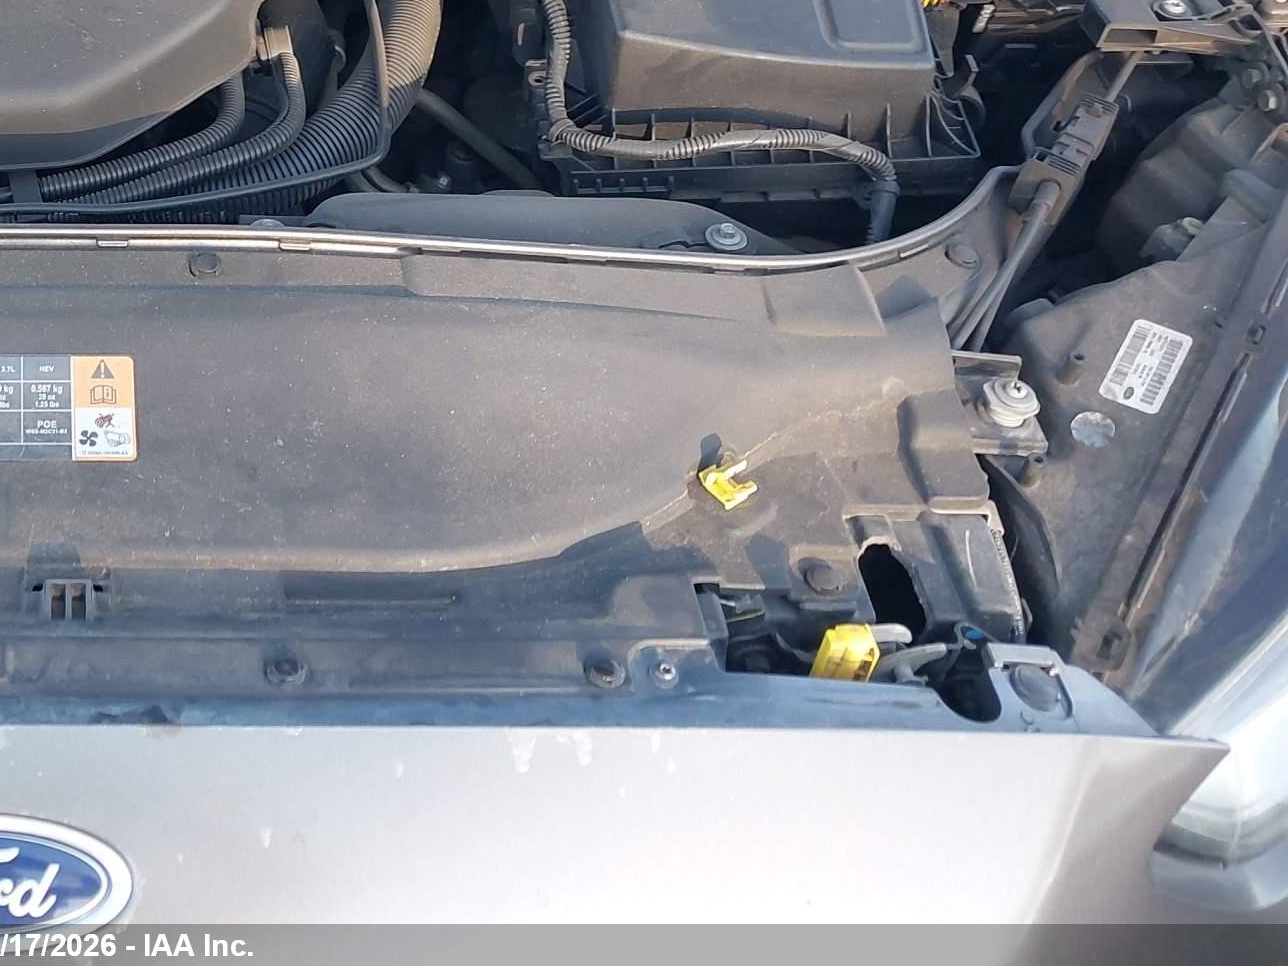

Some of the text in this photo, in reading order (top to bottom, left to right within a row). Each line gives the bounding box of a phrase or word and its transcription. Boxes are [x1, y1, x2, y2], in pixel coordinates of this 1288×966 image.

[3, 384, 14, 394] kg
[52, 384, 63, 395] kg
[37, 420, 57, 429] POE
